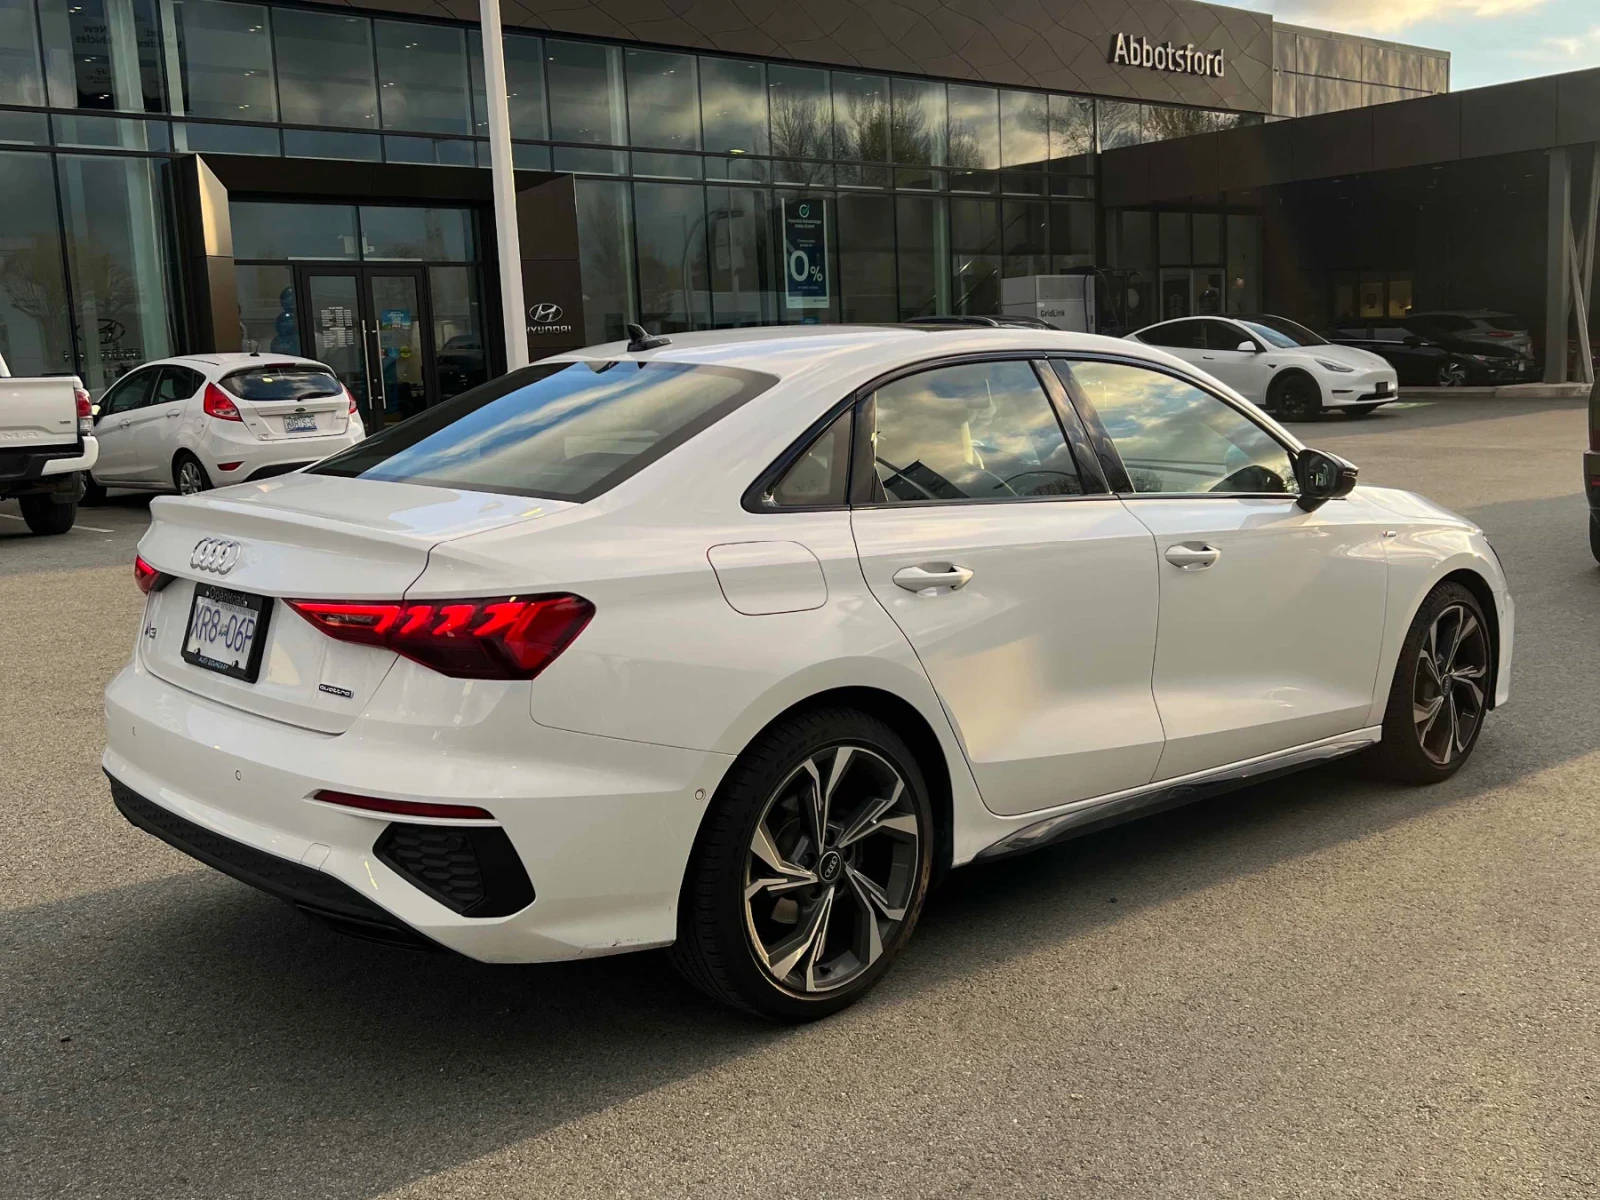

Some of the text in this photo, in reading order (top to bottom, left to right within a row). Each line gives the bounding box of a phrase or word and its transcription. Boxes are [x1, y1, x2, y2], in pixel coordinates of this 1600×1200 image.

[1114, 32, 1225, 77] Abbotsford
[1040, 309, 1065, 317] GridLink
[210, 586, 246, 606] OpenRoad
[319, 684, 350, 697] quattro
